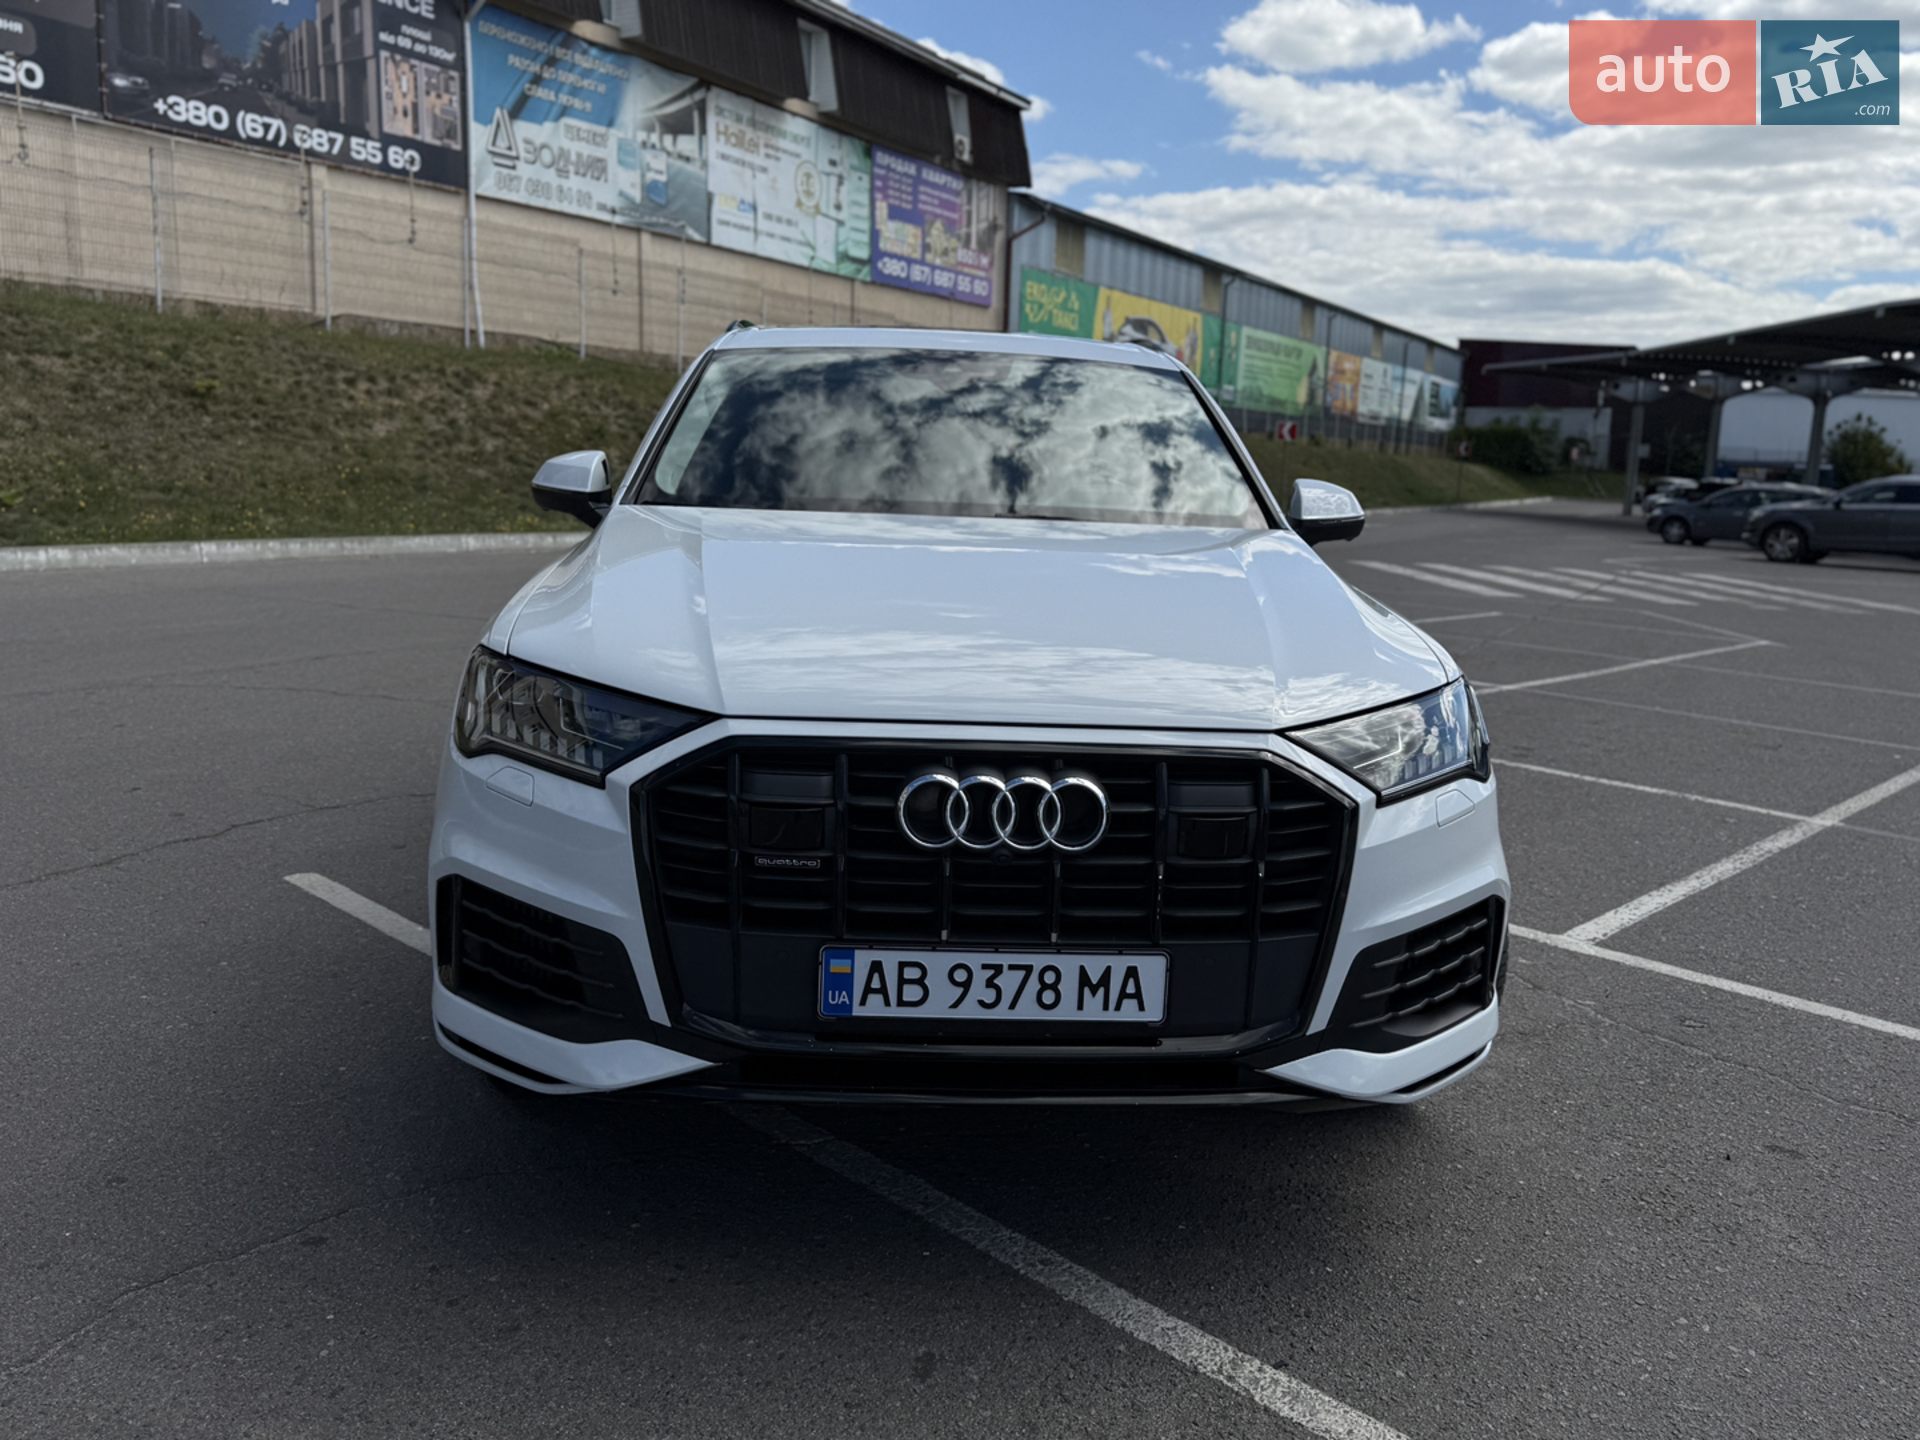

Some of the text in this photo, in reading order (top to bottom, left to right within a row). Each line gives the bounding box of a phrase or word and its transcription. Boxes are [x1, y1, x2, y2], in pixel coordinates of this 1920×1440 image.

[154, 94, 421, 173] +380 (67) 687 55 60
[757, 858, 817, 867] quattro
[827, 990, 850, 1006] UA
[858, 959, 1146, 1012] AB 9378 MA
